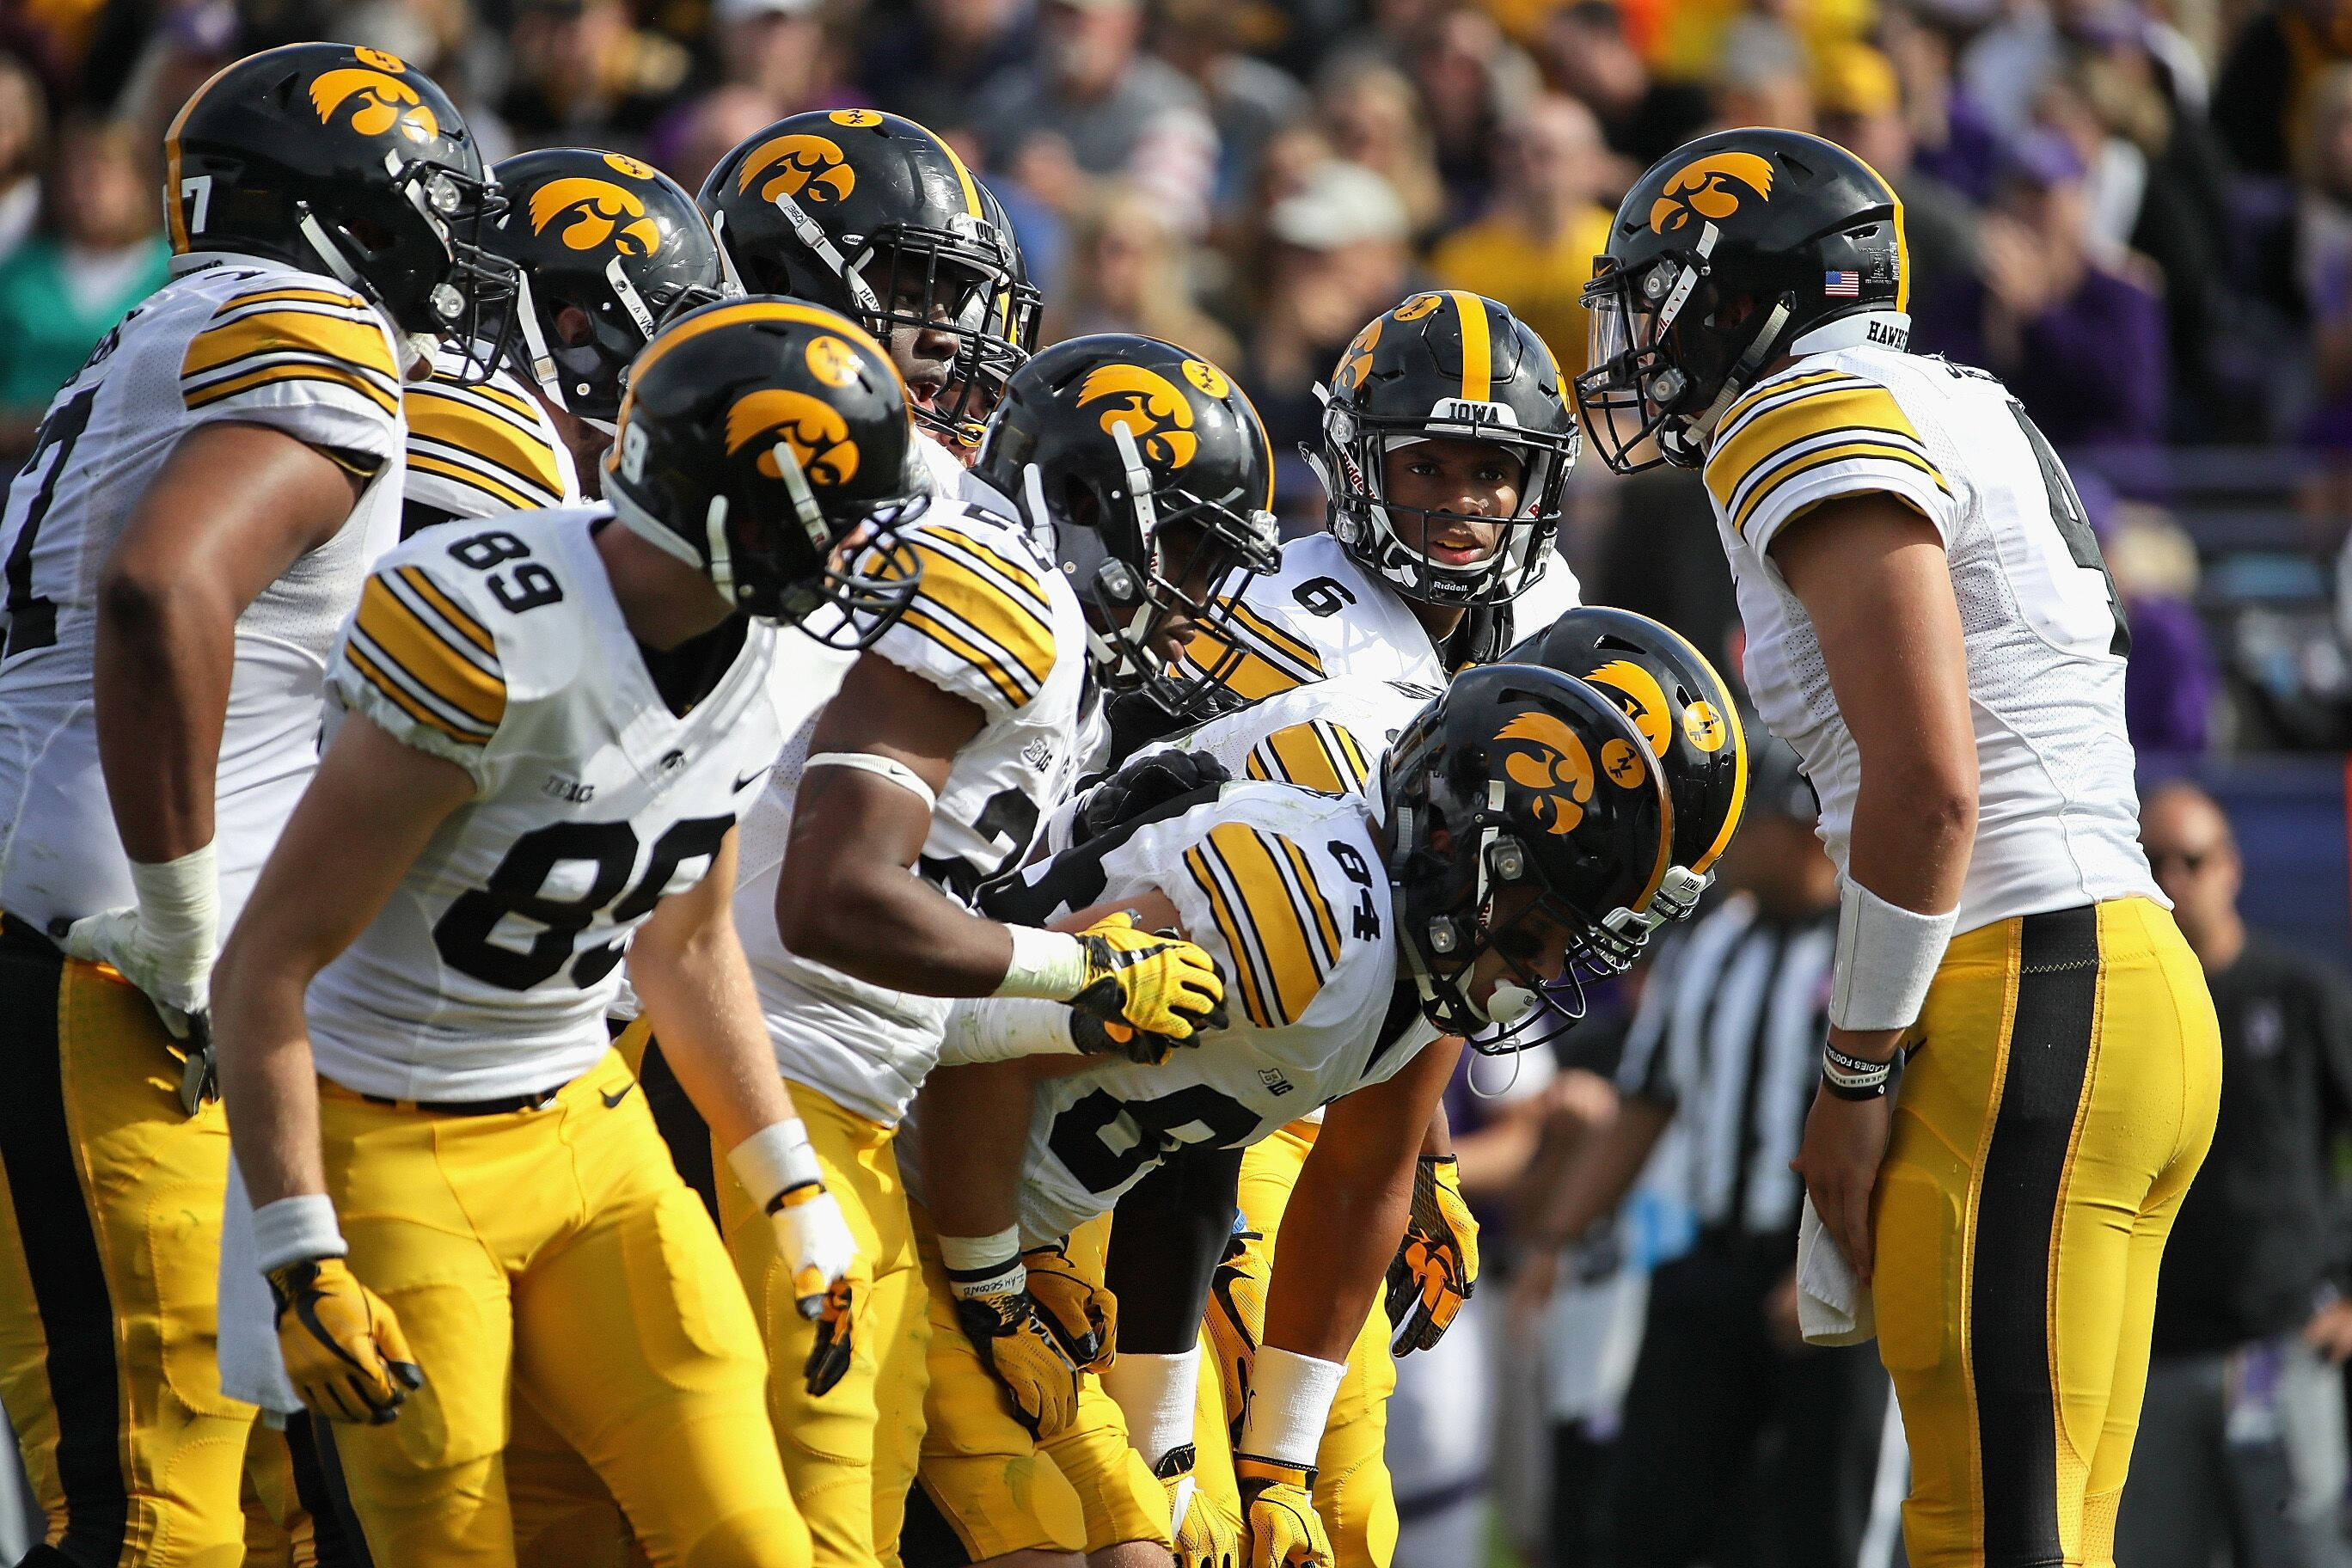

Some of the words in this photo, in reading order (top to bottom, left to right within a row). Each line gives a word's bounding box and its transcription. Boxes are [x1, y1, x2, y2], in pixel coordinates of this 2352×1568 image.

[843, 236, 861, 245] Ridd
[1866, 320, 1909, 349] HAWK
[1449, 403, 1500, 423] IOWA
[447, 530, 564, 614] 89
[1291, 575, 1357, 618] 6
[1326, 839, 1381, 943] 84
